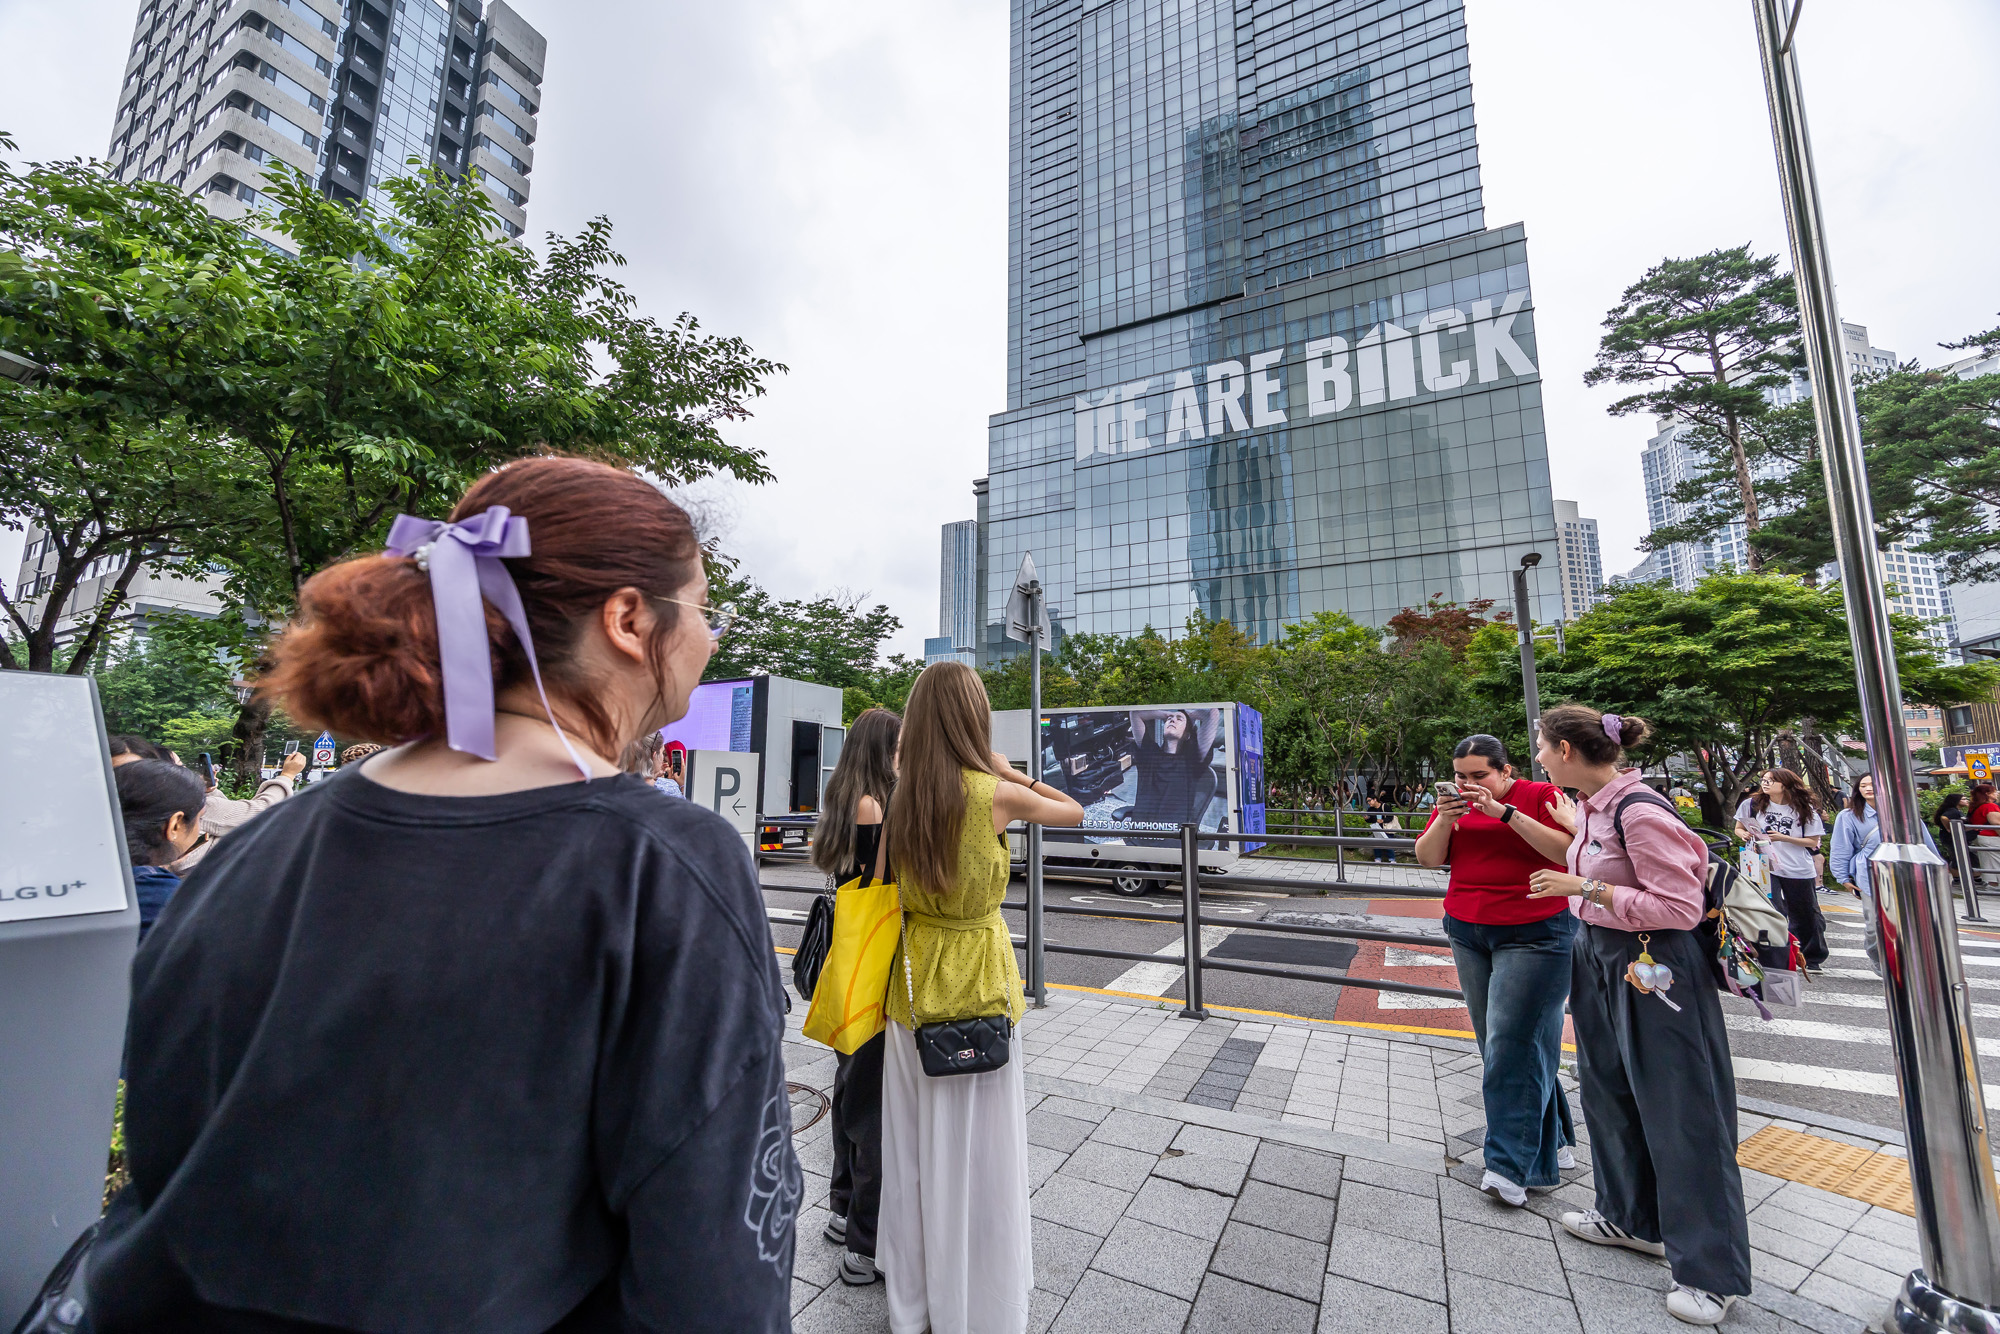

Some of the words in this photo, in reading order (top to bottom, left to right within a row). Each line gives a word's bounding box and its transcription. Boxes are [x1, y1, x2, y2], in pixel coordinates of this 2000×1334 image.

[1165, 347, 1288, 445] ARE
[714, 767, 741, 814] P
[1082, 819, 1108, 829] BEATS
[1110, 820, 1122, 829] TO
